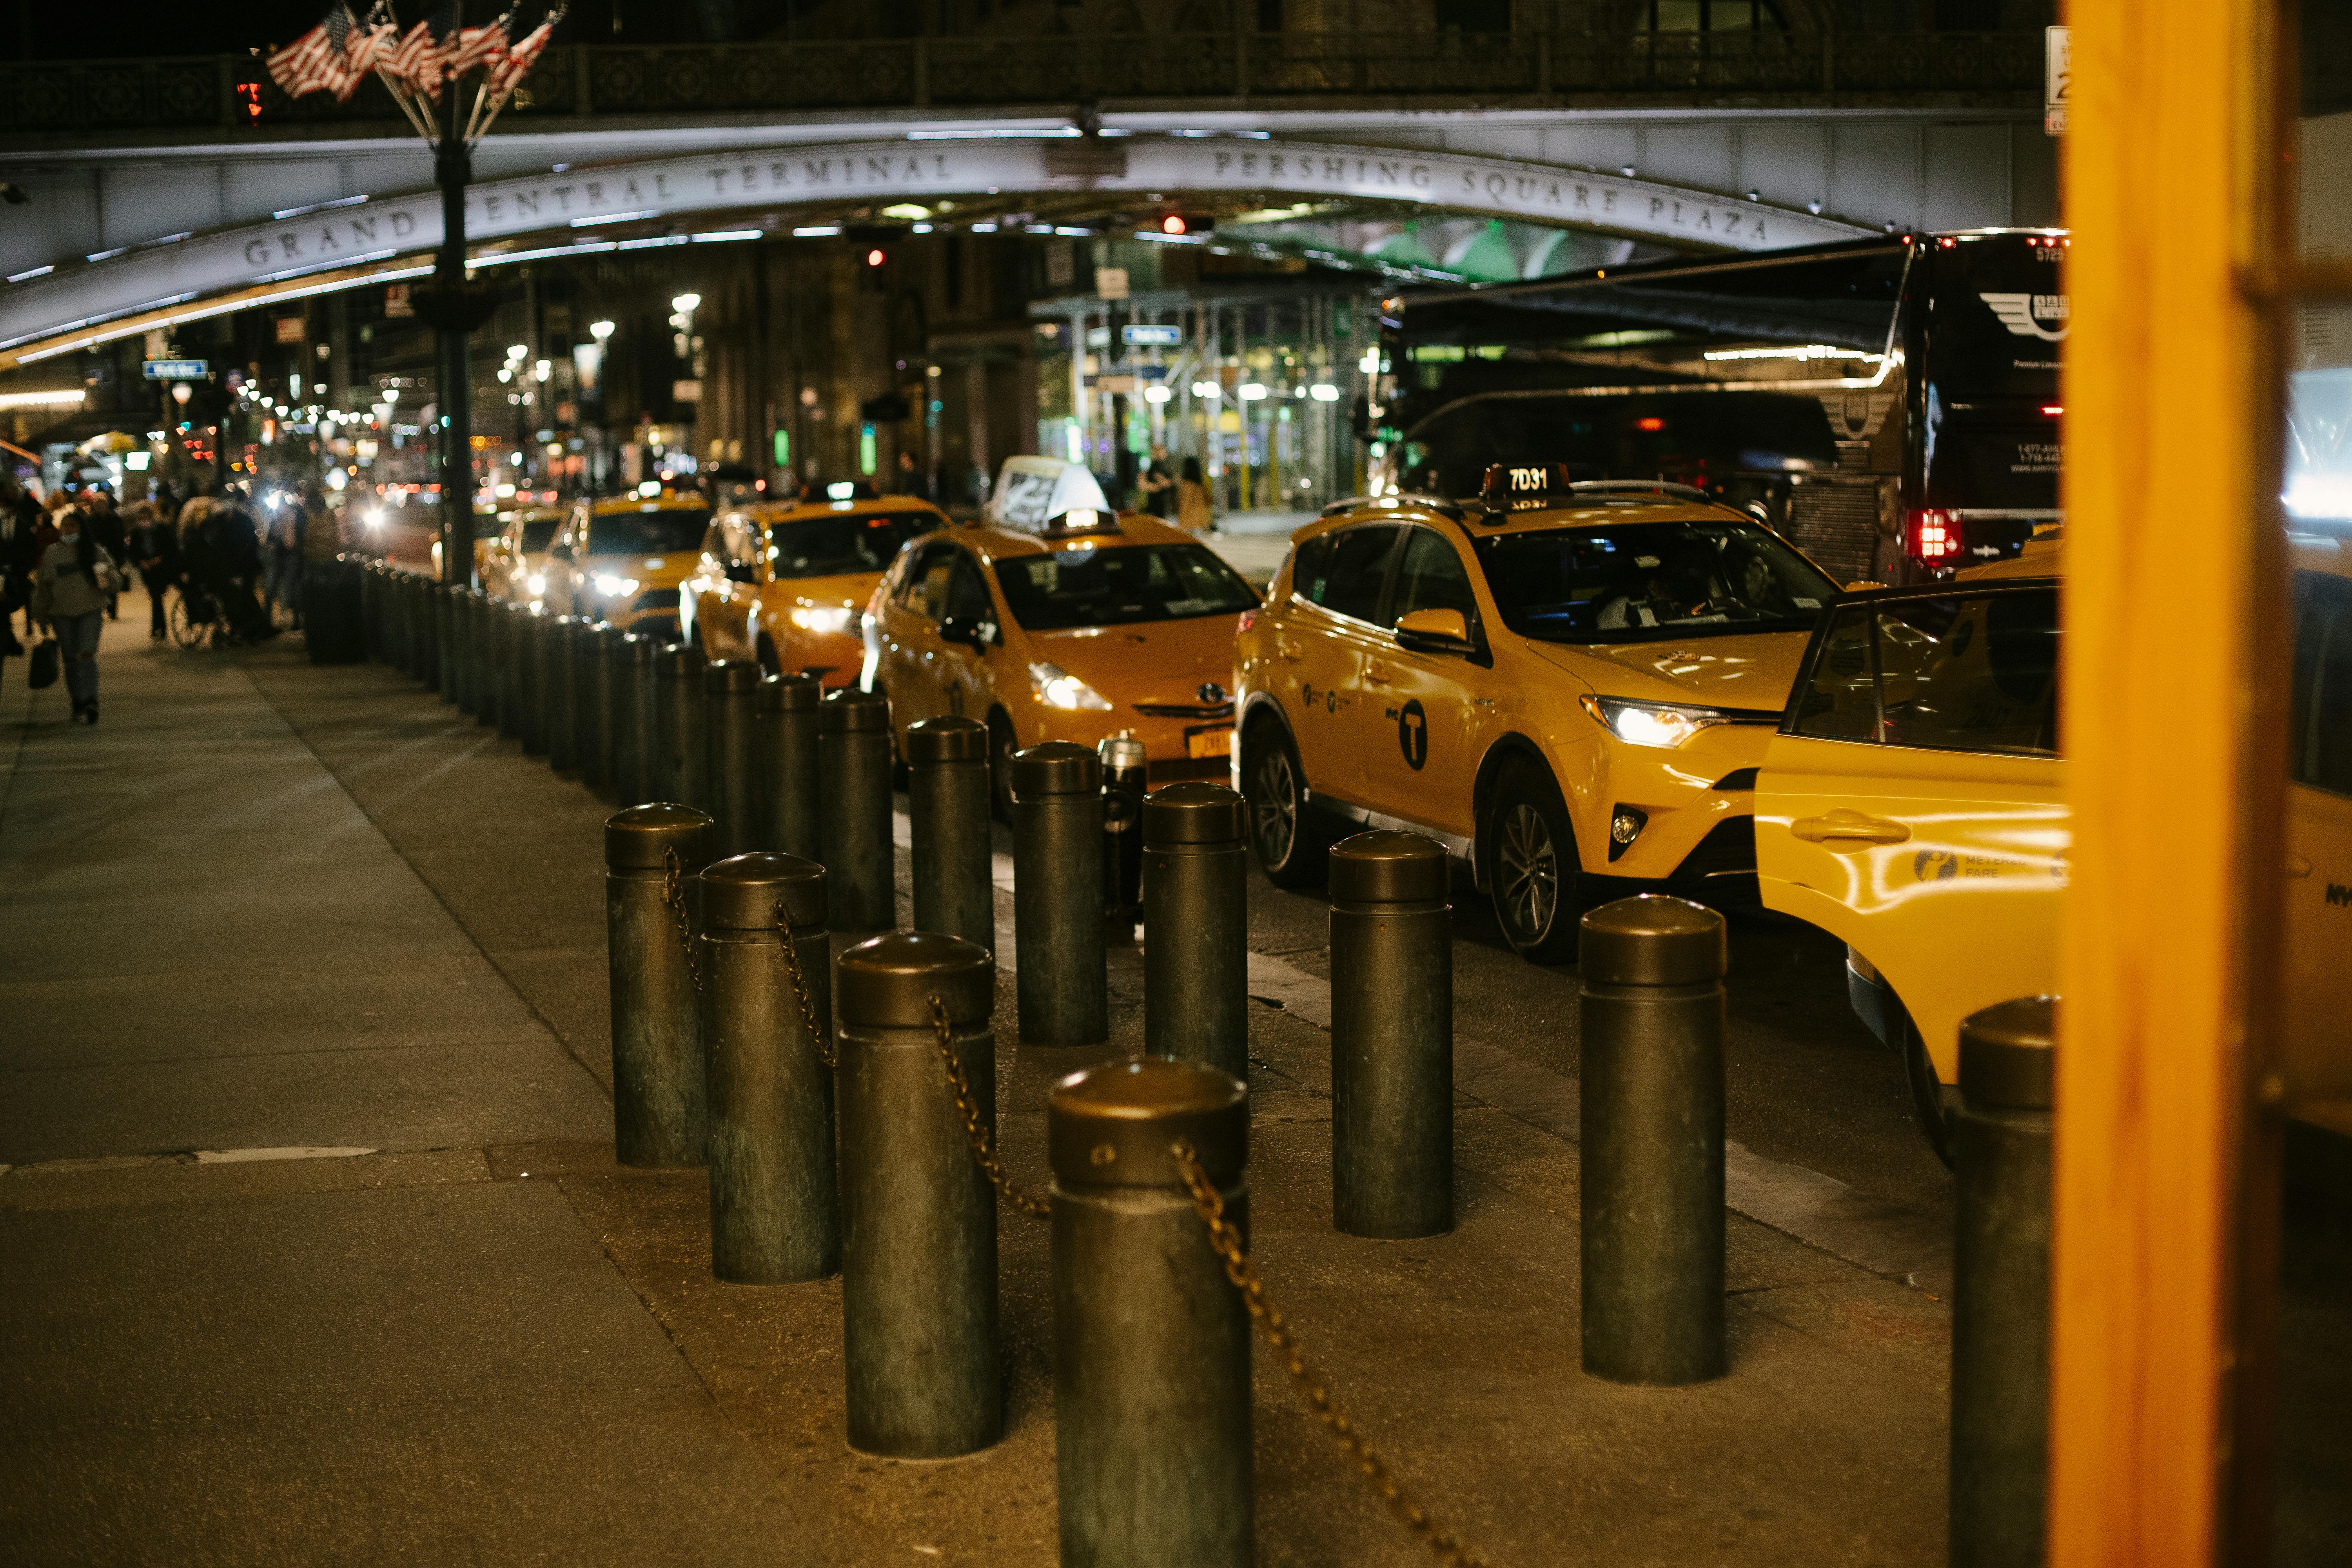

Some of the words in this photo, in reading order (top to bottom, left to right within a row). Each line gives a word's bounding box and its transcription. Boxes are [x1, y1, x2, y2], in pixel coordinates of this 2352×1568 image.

[244, 210, 417, 266] GRAND
[466, 175, 672, 222] ENTRAL
[709, 155, 951, 192] TERMINAL
[1215, 151, 1432, 189] PERSHING
[1461, 169, 1619, 213] SQUARE
[1650, 196, 1769, 242] PLAZA
[1509, 467, 1548, 492] 7D31
[1405, 713, 1421, 762] T
[1966, 855, 2027, 866] METERED
[1966, 868, 1998, 878] FARE
